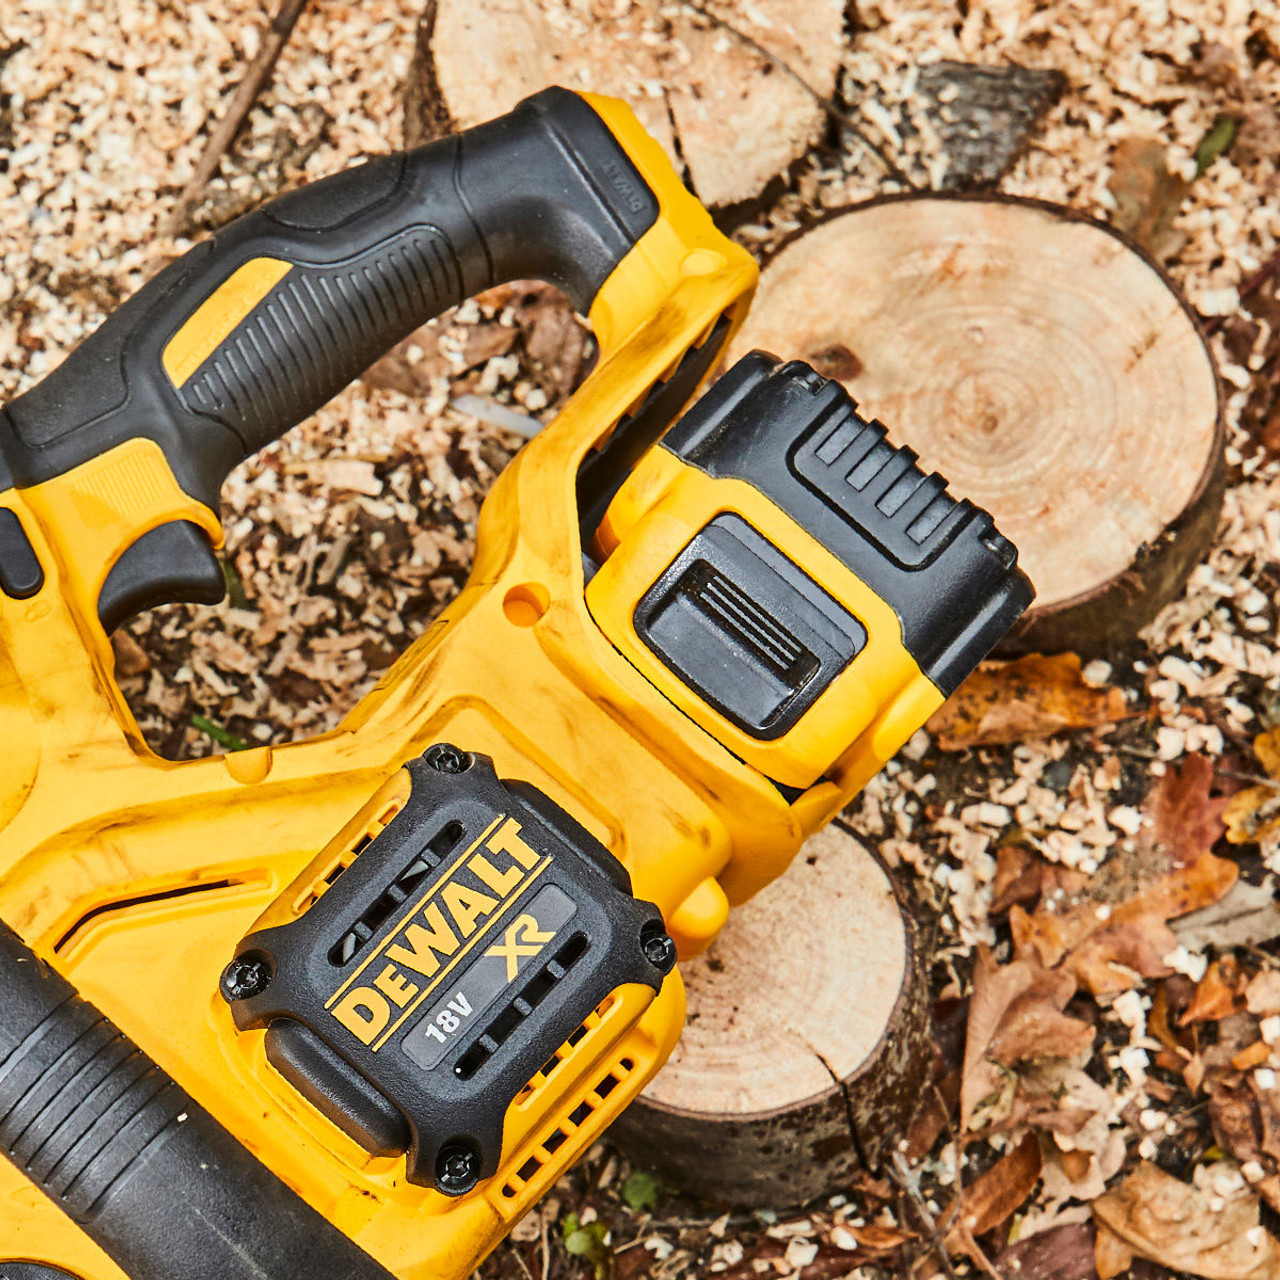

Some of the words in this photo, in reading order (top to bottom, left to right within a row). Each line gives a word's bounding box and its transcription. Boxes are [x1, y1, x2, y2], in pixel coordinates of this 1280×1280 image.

[331, 817, 541, 1046] DEWALT
[425, 992, 473, 1043] 18V
[483, 913, 557, 983] XR
